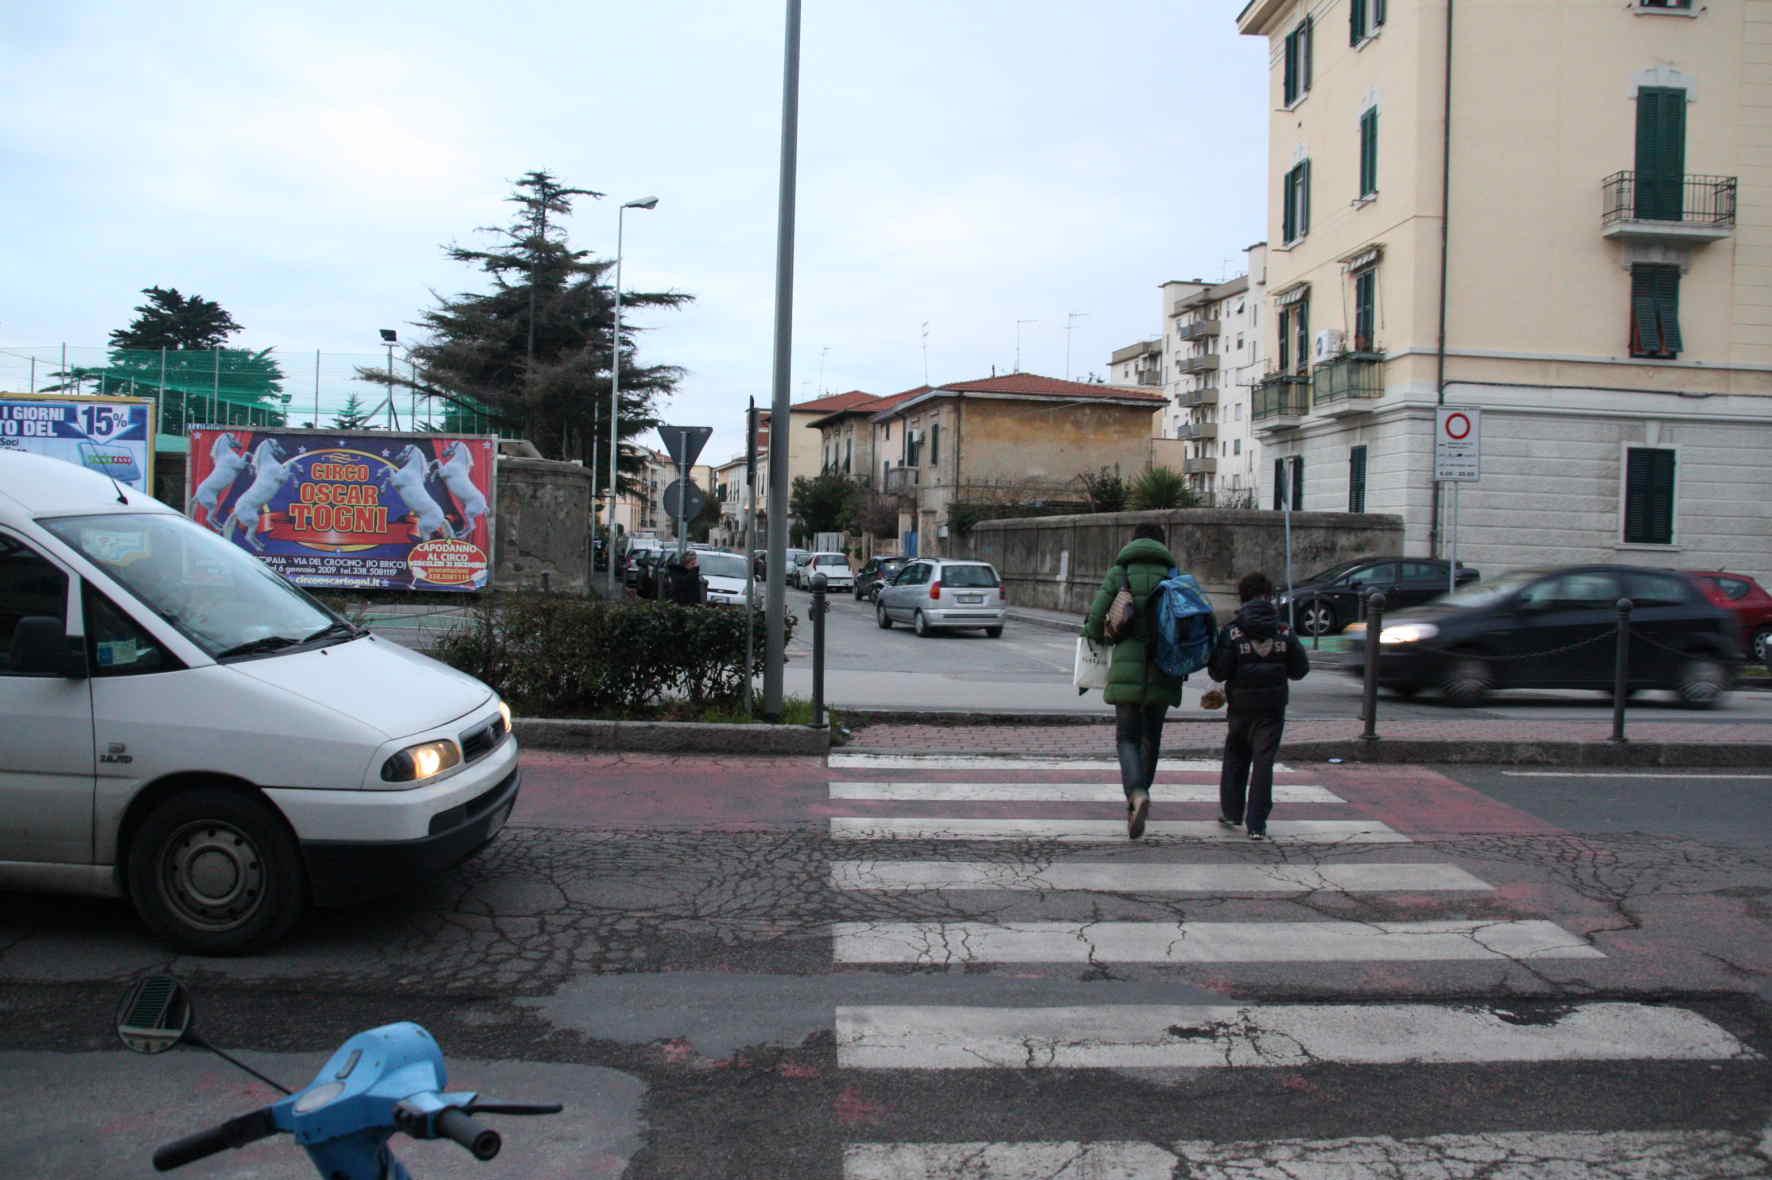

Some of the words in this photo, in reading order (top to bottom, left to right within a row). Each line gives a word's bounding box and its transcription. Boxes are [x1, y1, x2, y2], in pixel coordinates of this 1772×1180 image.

[3, 406, 8, 420] I
[13, 406, 65, 421] GIORNI
[82, 405, 128, 436] 15%
[23, 420, 58, 436] DEL
[312, 463, 369, 482] CIRCO
[300, 482, 379, 505] OSCAR
[289, 503, 388, 534] TOGNI
[416, 543, 477, 553] CAPODANNO
[293, 557, 307, 566] VIA
[309, 558, 322, 566] DEL
[427, 552, 439, 561] AL
[440, 553, 469, 562] CIRCO
[286, 566, 316, 575] gennaio
